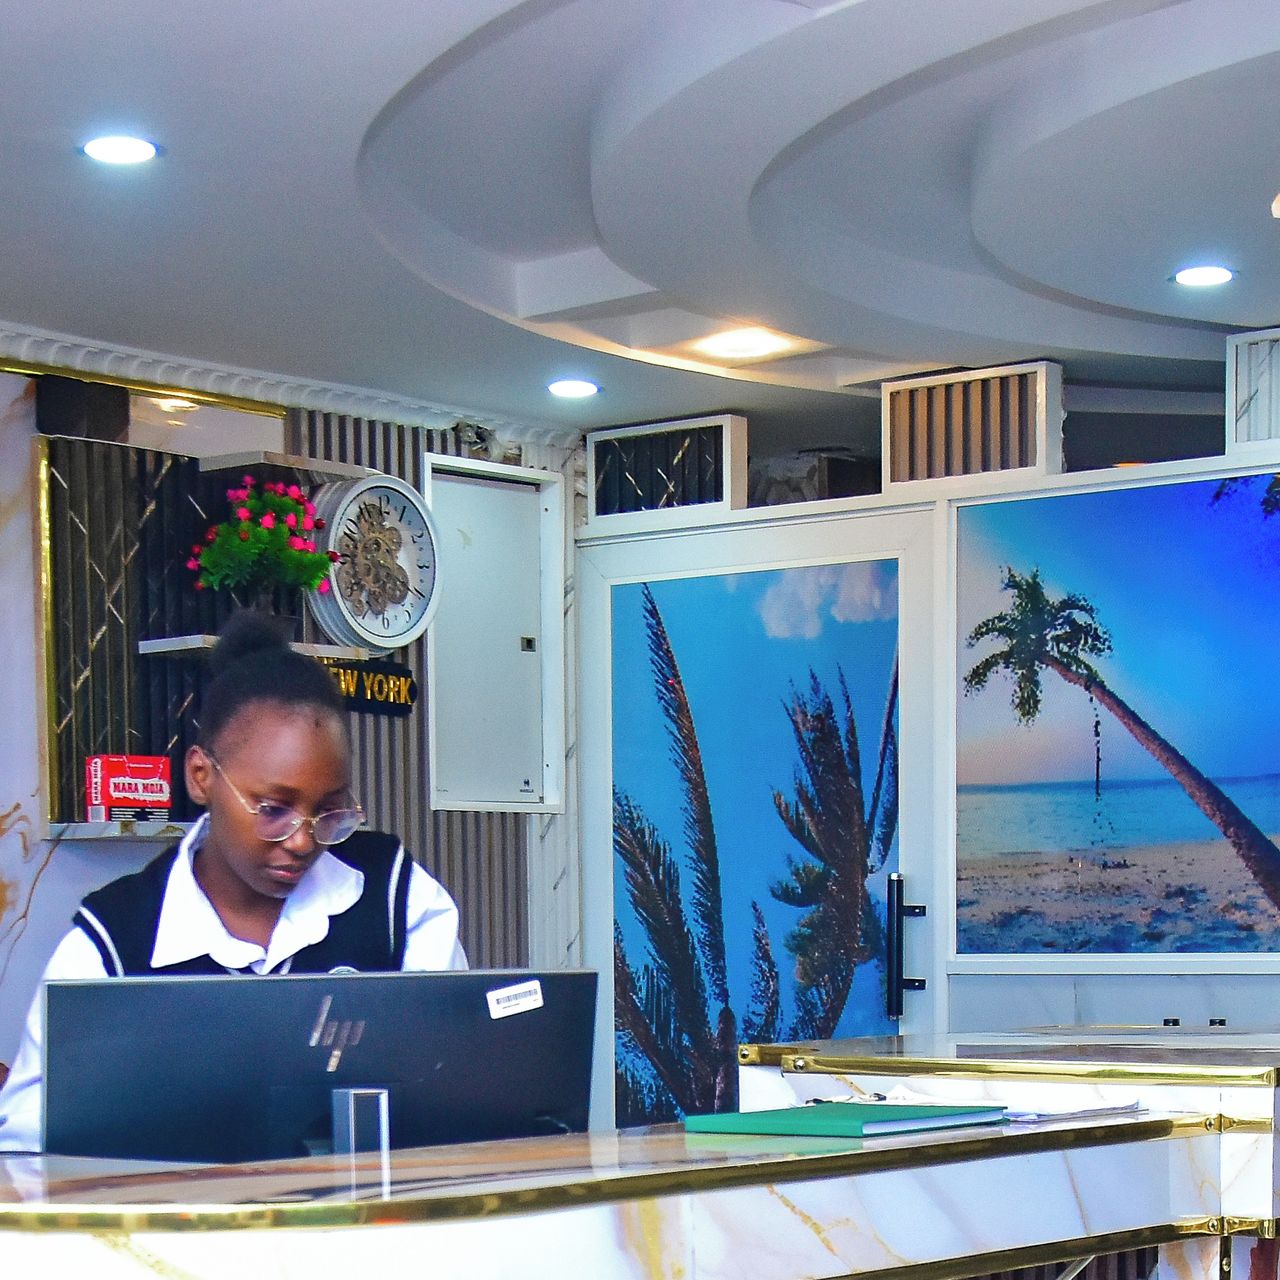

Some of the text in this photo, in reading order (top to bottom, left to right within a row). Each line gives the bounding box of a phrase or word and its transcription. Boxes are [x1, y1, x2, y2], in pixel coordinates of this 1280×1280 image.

[362, 671, 412, 705] YORK
[112, 781, 139, 793] MARA
[308, 995, 366, 1073] hp
